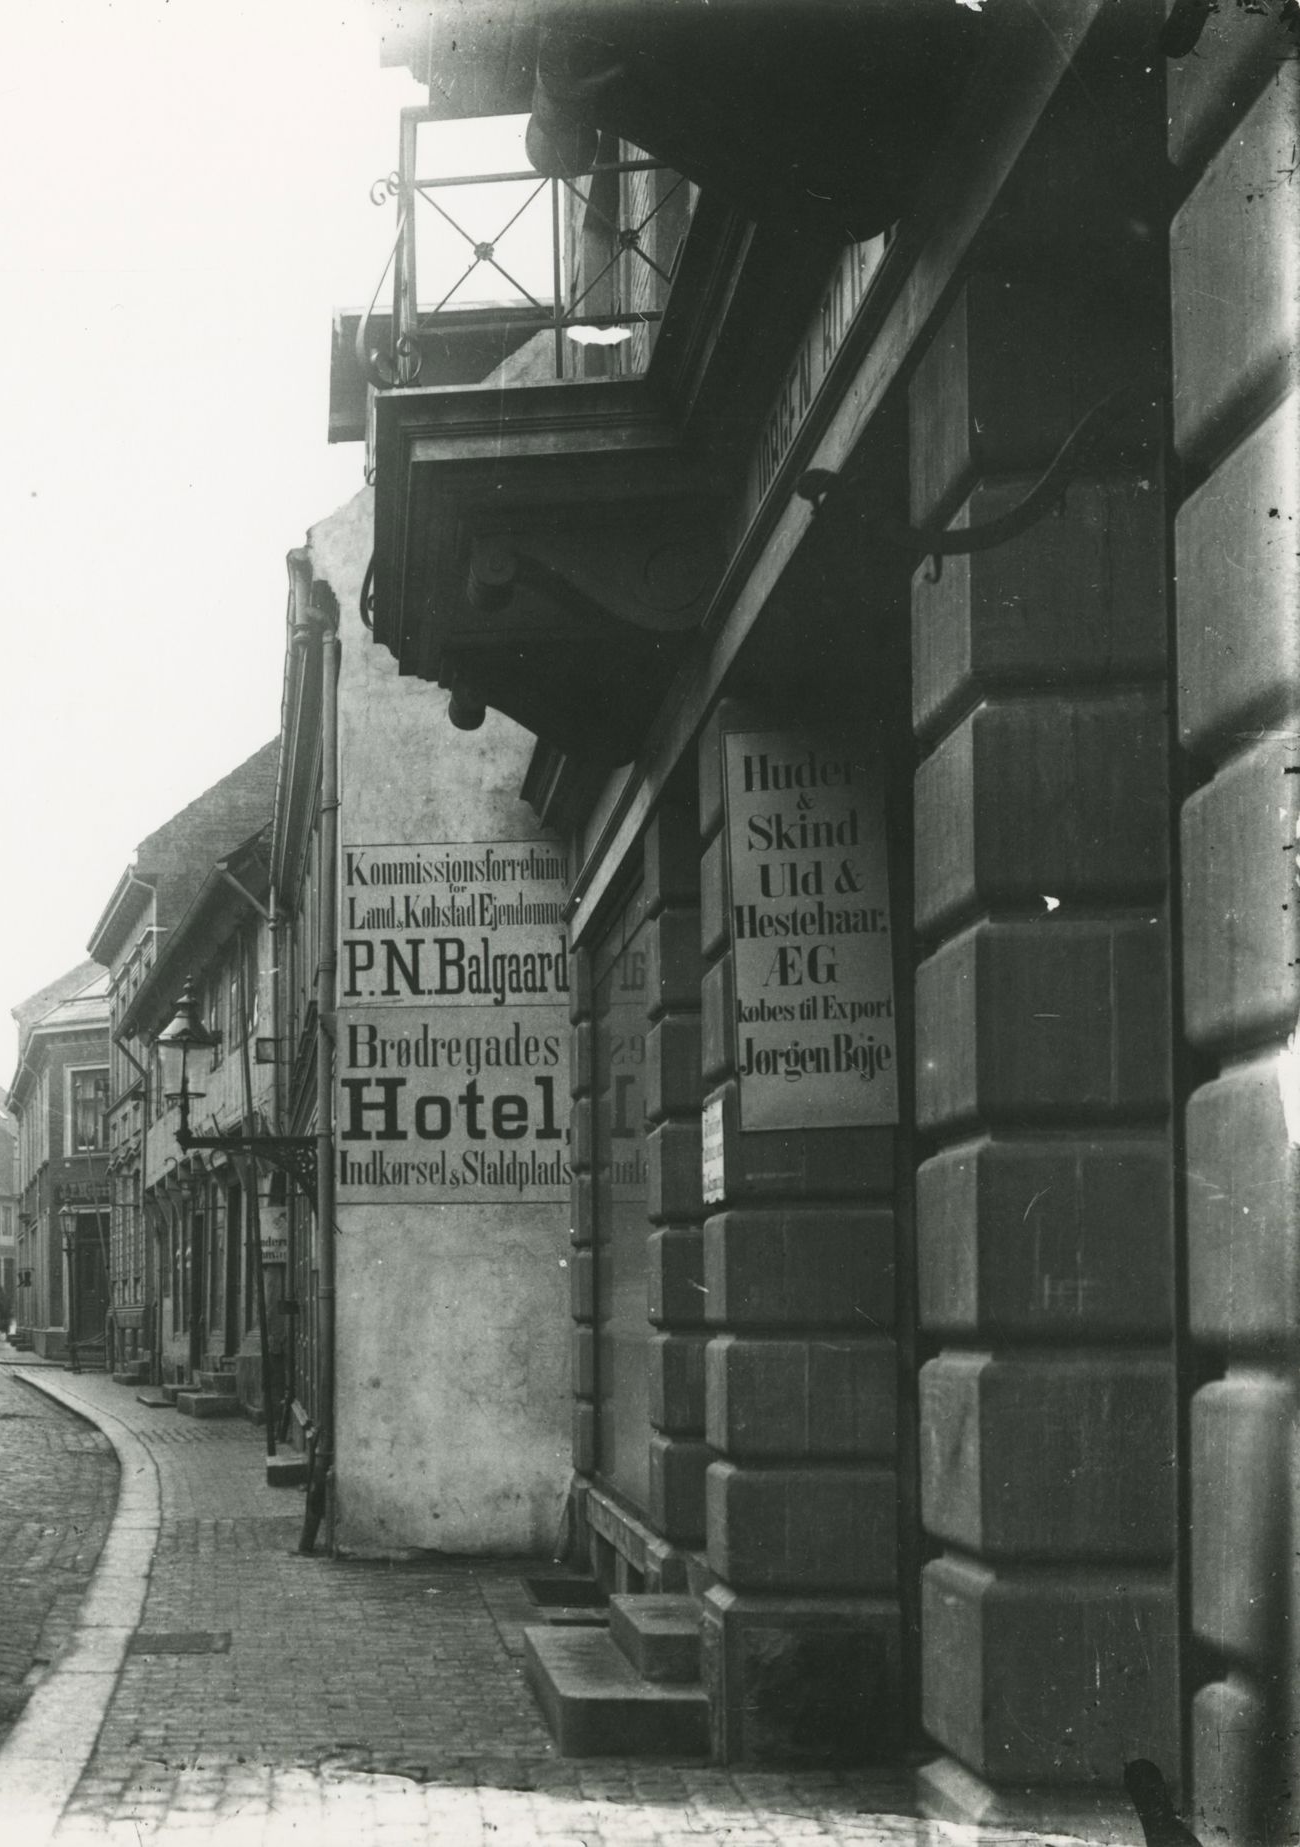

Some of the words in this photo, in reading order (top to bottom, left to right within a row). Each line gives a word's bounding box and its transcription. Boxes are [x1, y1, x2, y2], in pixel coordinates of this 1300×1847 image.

[796, 792, 817, 811] &
[748, 808, 859, 852] Skind
[345, 848, 569, 890] Kommissionsforretning
[449, 883, 467, 893] for
[758, 861, 824, 898] Uld
[834, 858, 866, 895] &
[762, 944, 839, 988] ÆG
[799, 995, 817, 1021] til
[821, 994, 894, 1024] Export
[347, 1022, 560, 1076] Brødregades
